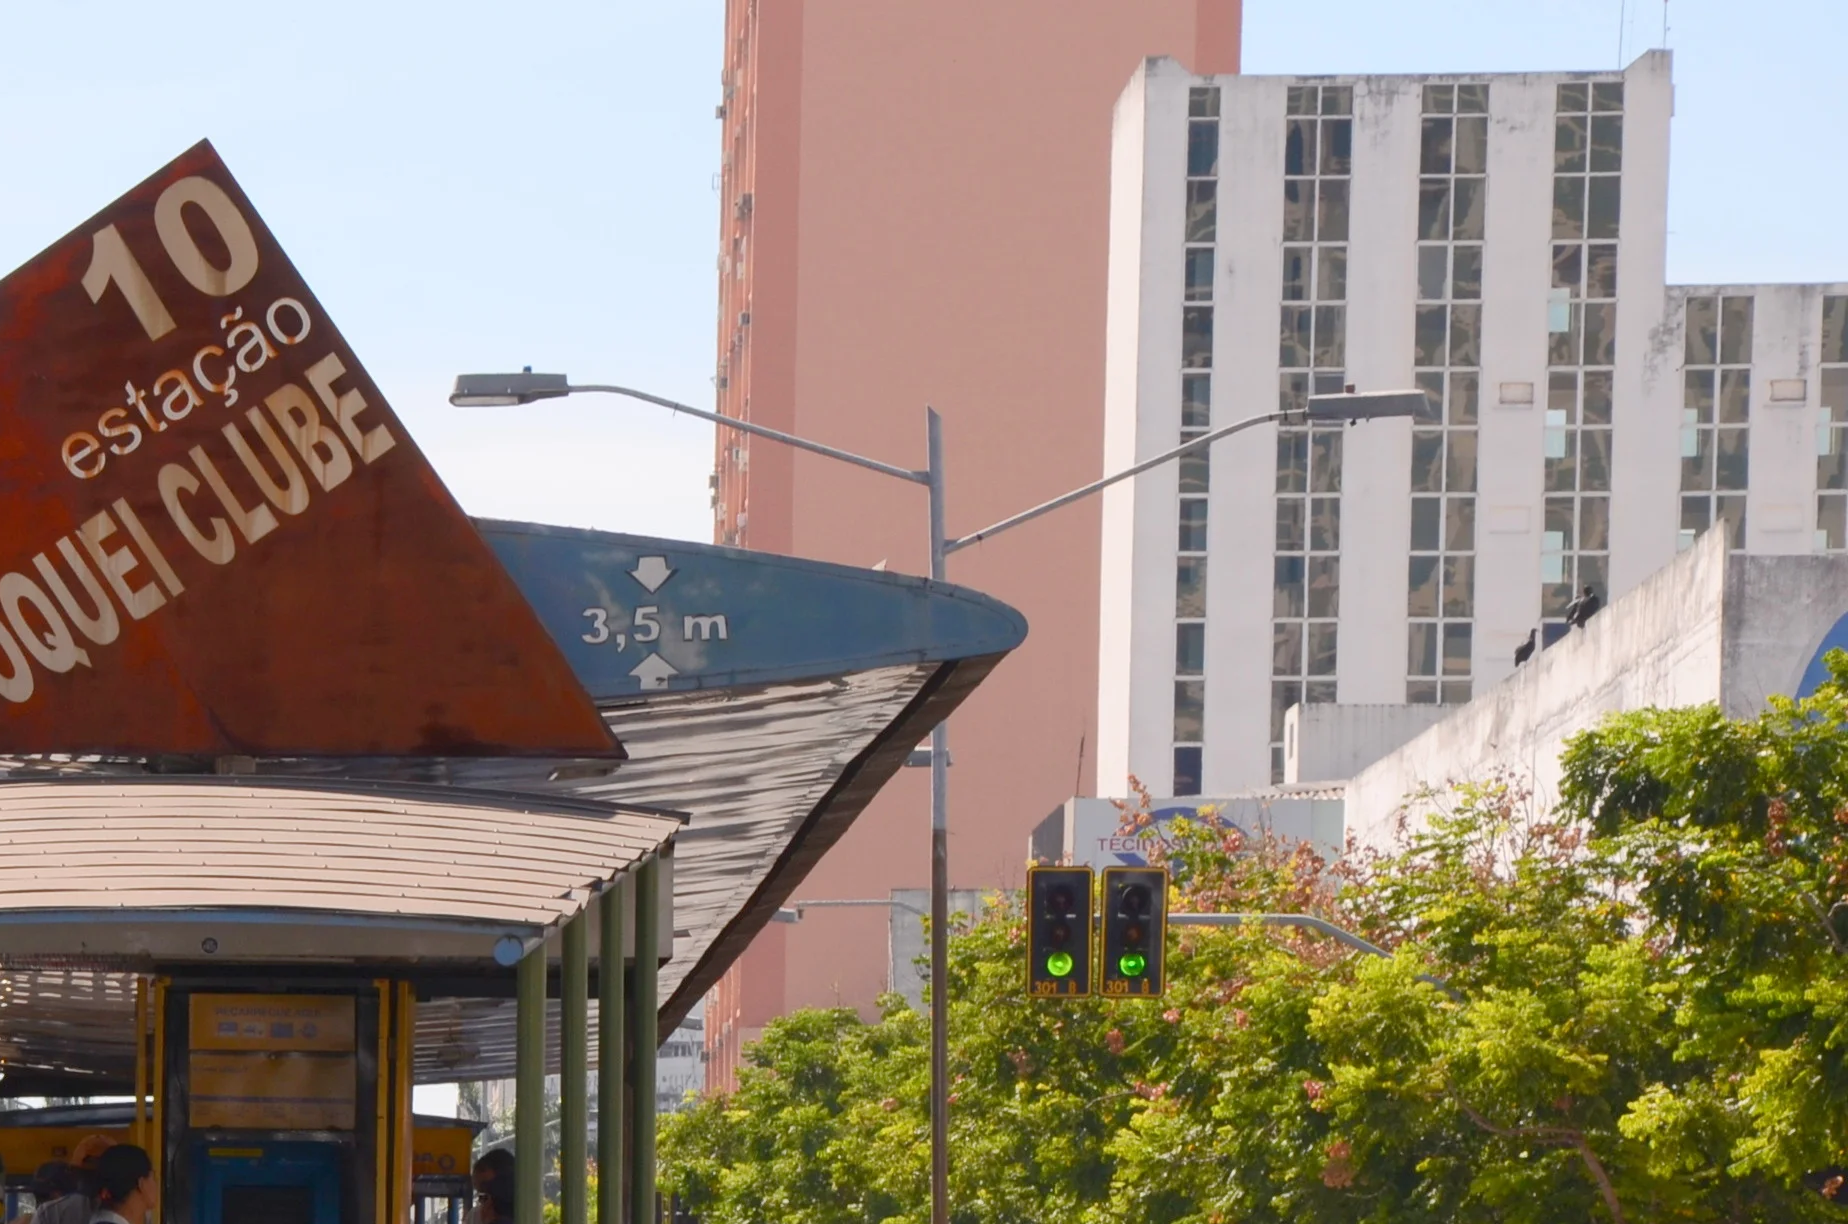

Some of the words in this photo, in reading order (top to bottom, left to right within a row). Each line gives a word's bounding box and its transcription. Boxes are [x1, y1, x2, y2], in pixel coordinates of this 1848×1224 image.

[80, 174, 260, 342] 10
[61, 295, 312, 480] estação
[157, 350, 397, 567] CLUBE
[581, 605, 661, 654] 3,5
[683, 614, 729, 641] m
[1096, 837, 1183, 852] TECIDS
